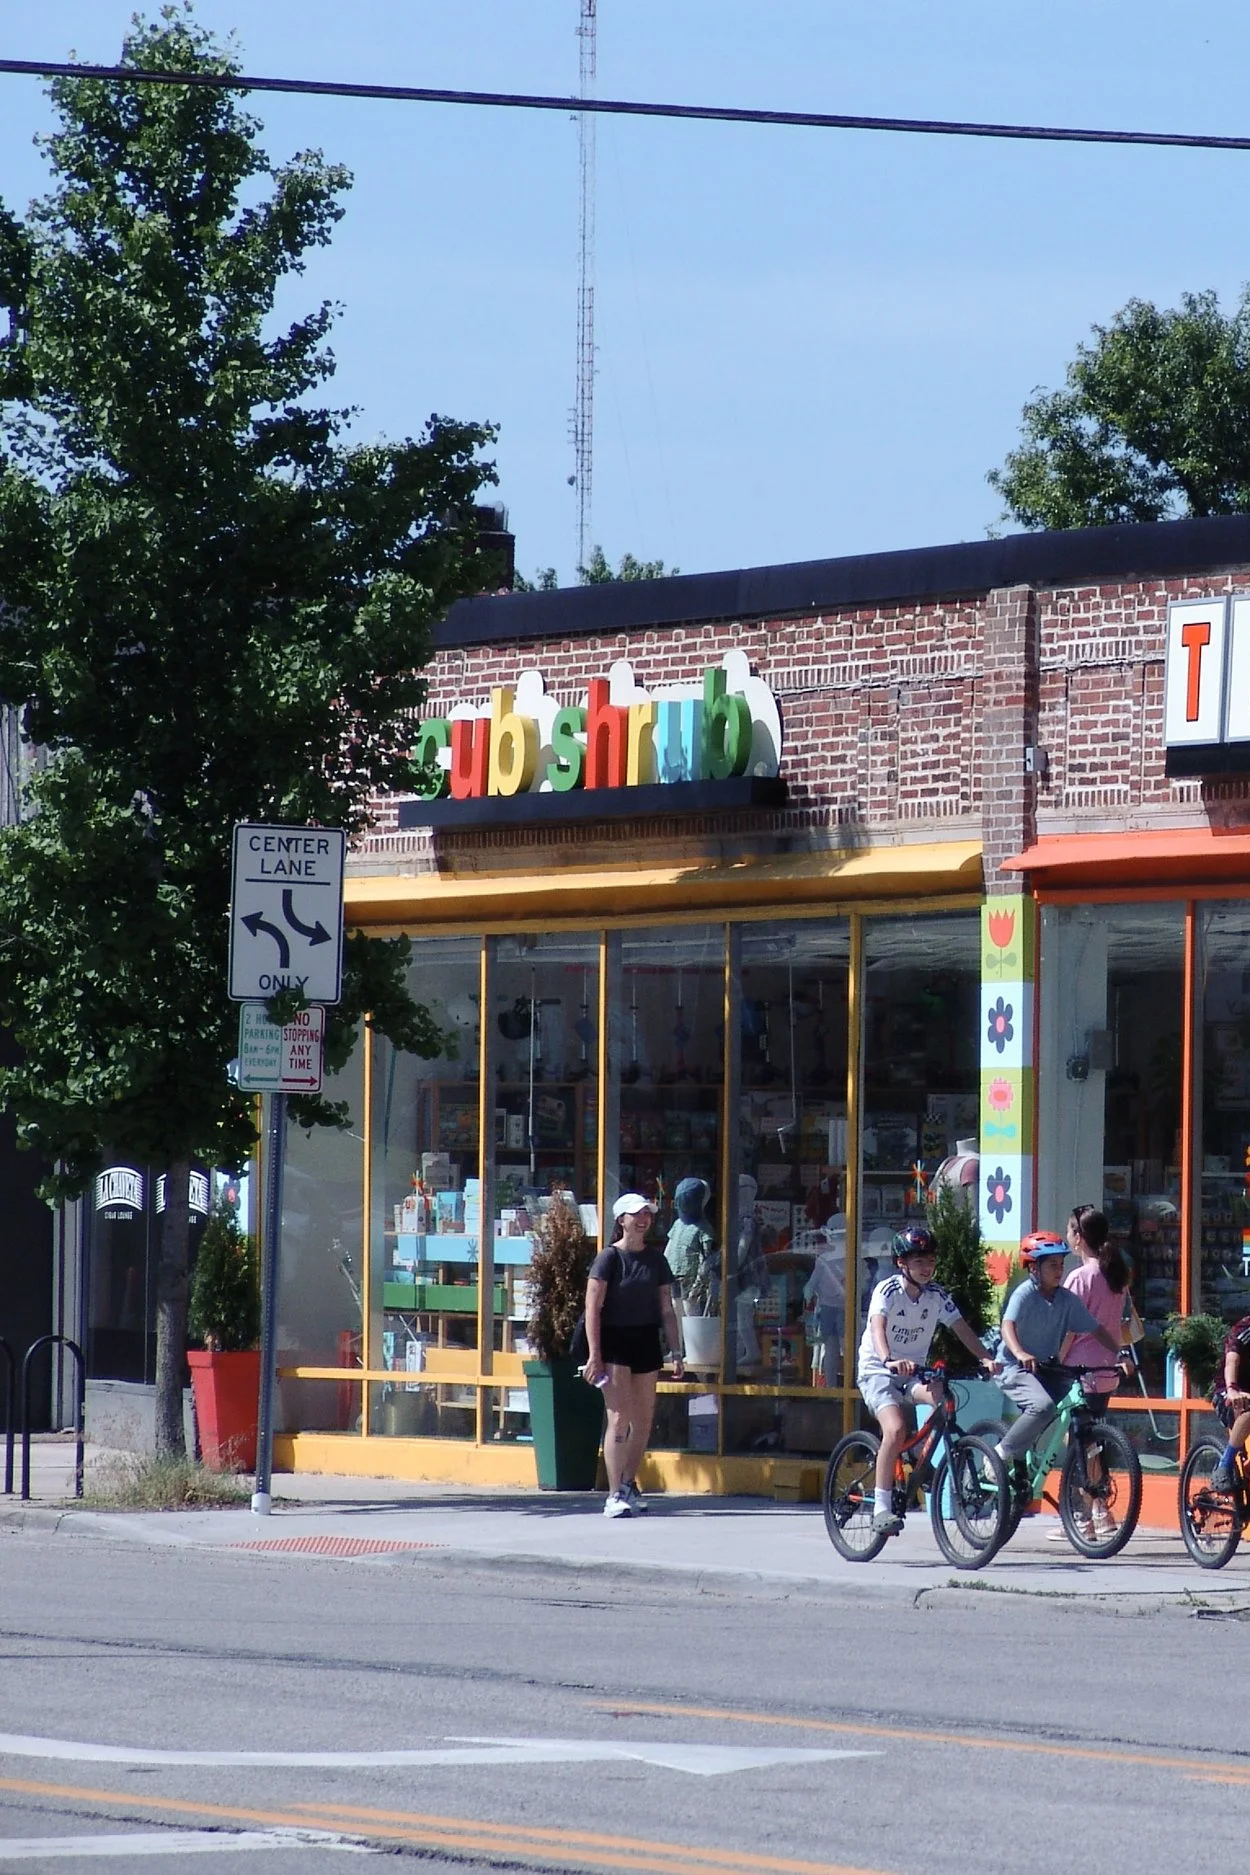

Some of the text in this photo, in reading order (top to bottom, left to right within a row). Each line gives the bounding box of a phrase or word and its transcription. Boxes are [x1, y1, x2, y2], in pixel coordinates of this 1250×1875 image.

[249, 835, 329, 855] CENTER
[260, 858, 316, 876] LANE
[258, 975, 309, 990] ONLY
[245, 1013, 251, 1025] 2
[294, 1012, 310, 1026] NO
[244, 1028, 280, 1040] PARKING
[283, 1028, 320, 1043] STOPPING
[290, 1045, 312, 1056] ANY
[289, 1058, 312, 1070] TIME
